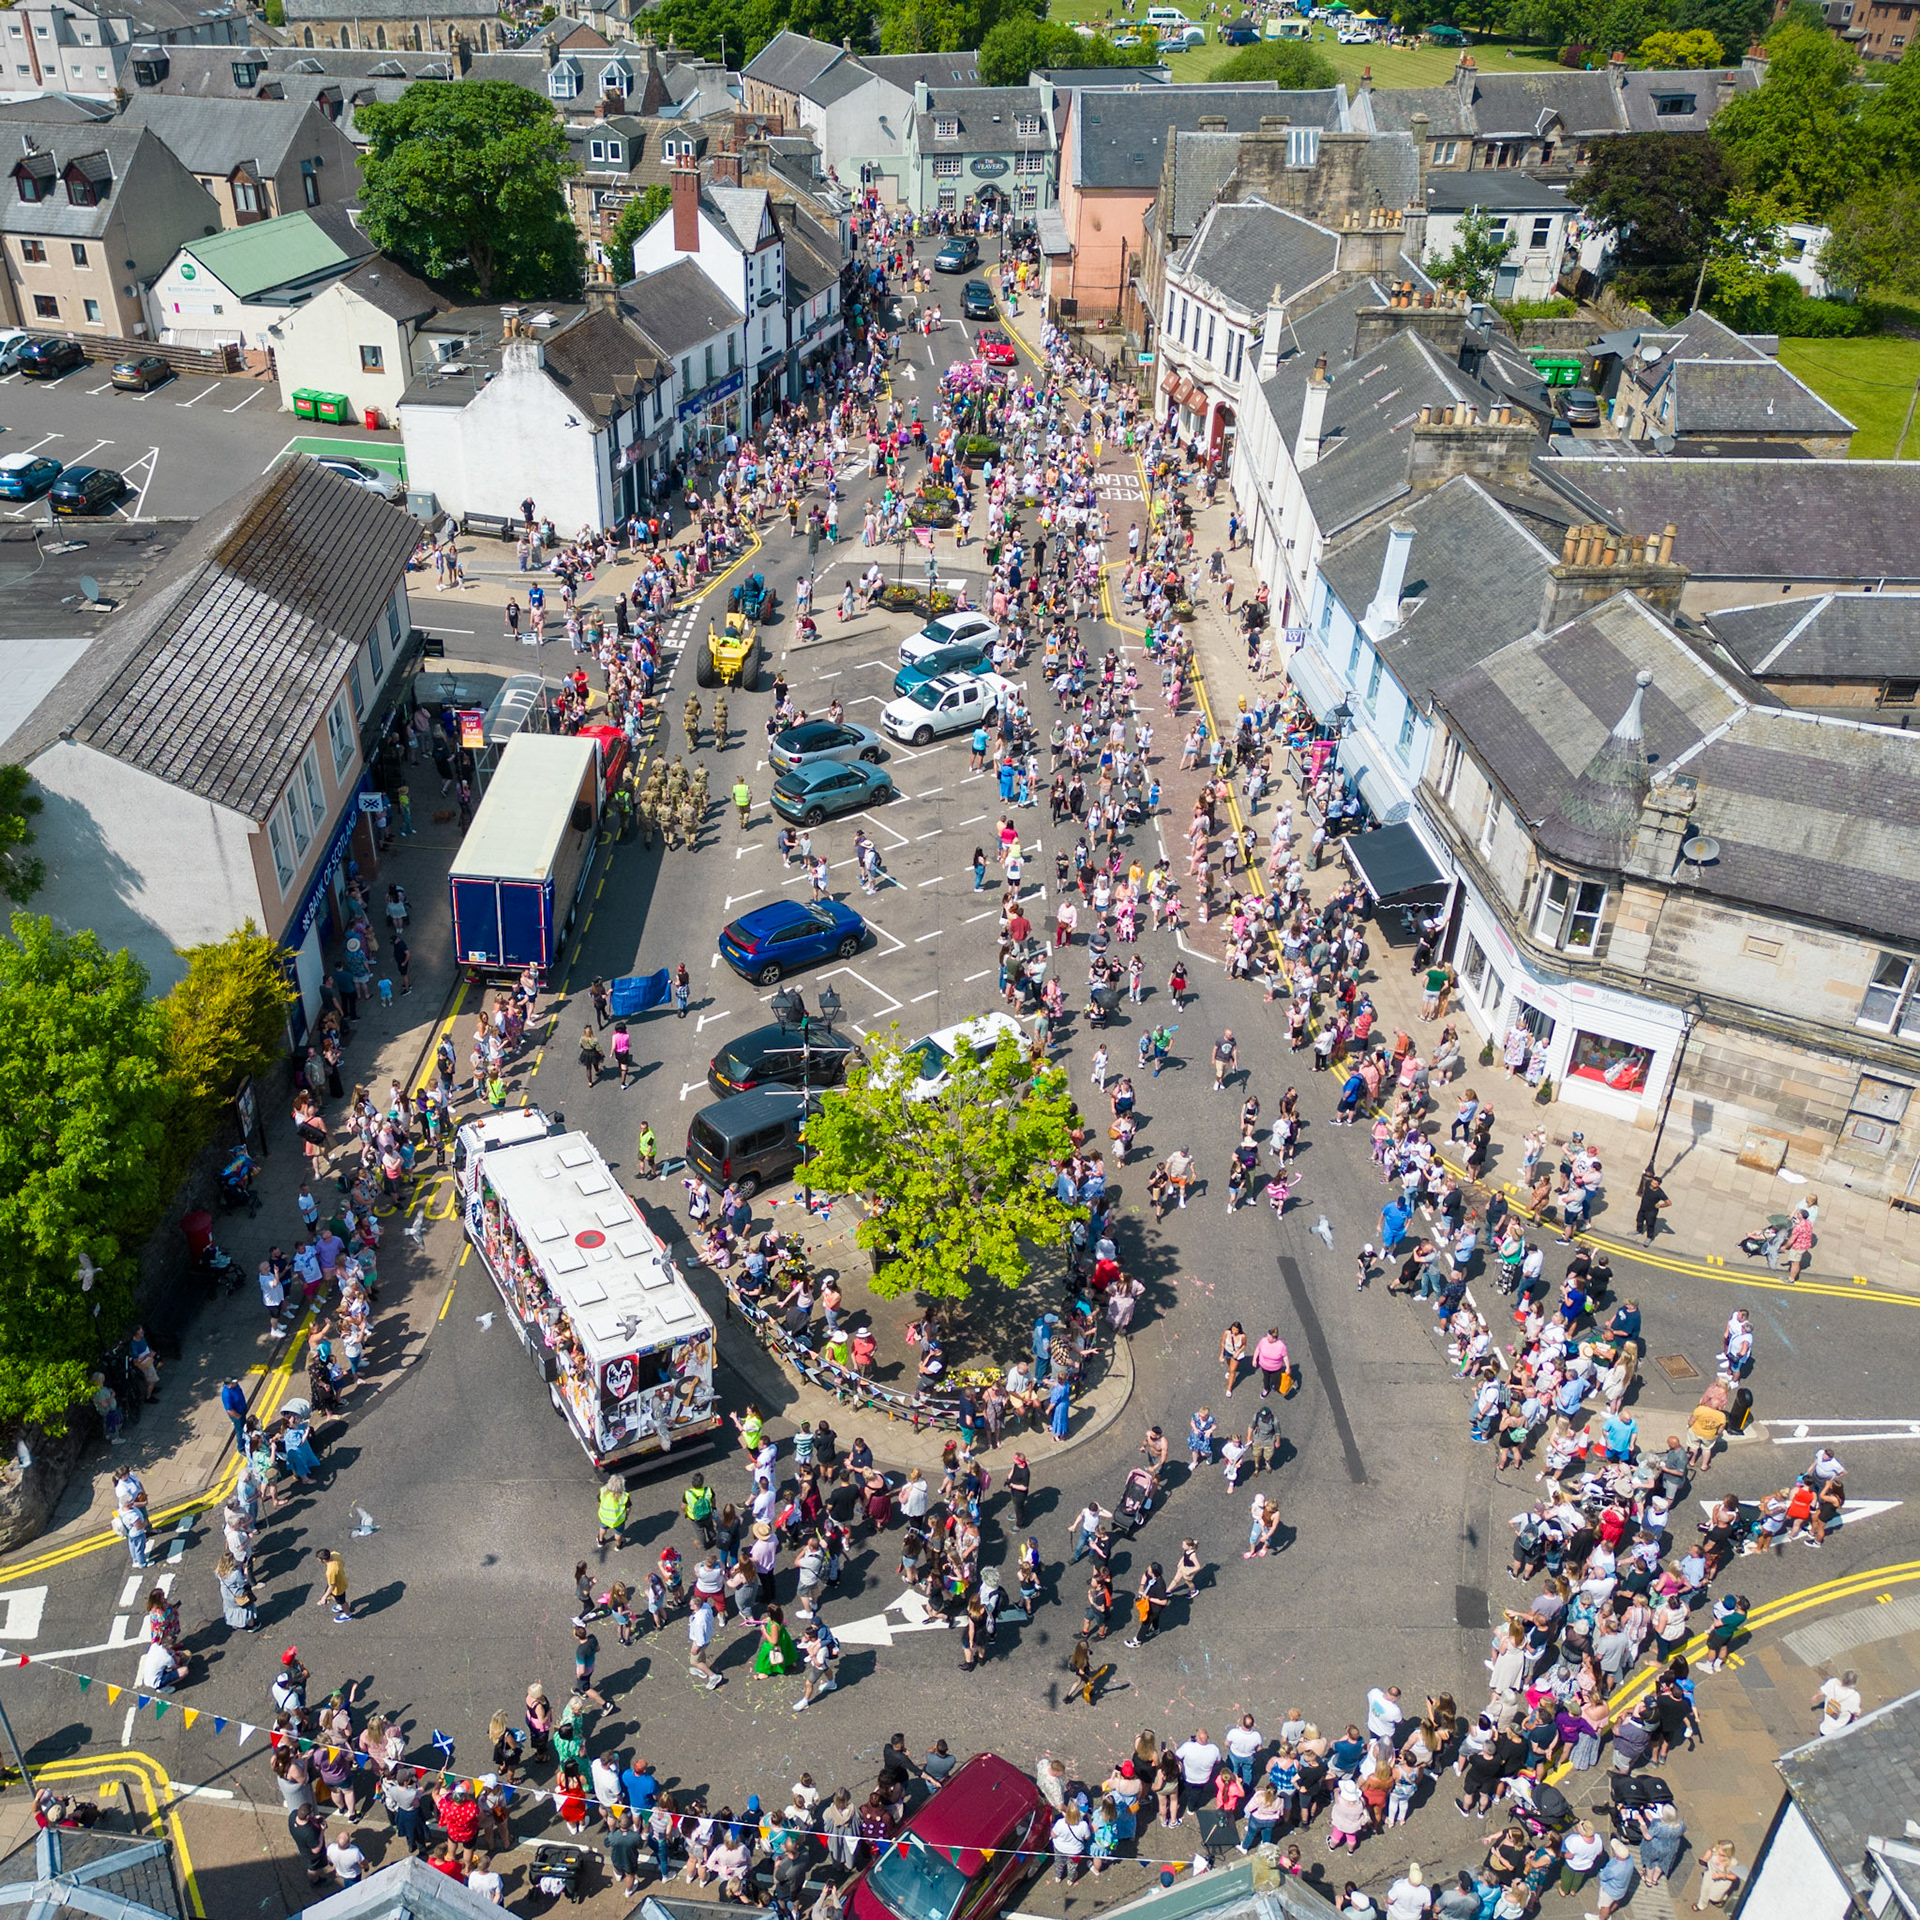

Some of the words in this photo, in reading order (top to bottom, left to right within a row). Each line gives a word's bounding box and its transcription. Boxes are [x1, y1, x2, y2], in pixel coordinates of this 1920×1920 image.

[1093, 473, 1139, 487] CLEAR
[1099, 488, 1145, 501] KEEP
[308, 883, 325, 918] BANK
[331, 811, 357, 869] SCOTLAND
[1600, 992, 1621, 1004] Your
[1624, 1000, 1662, 1015] Boutique
